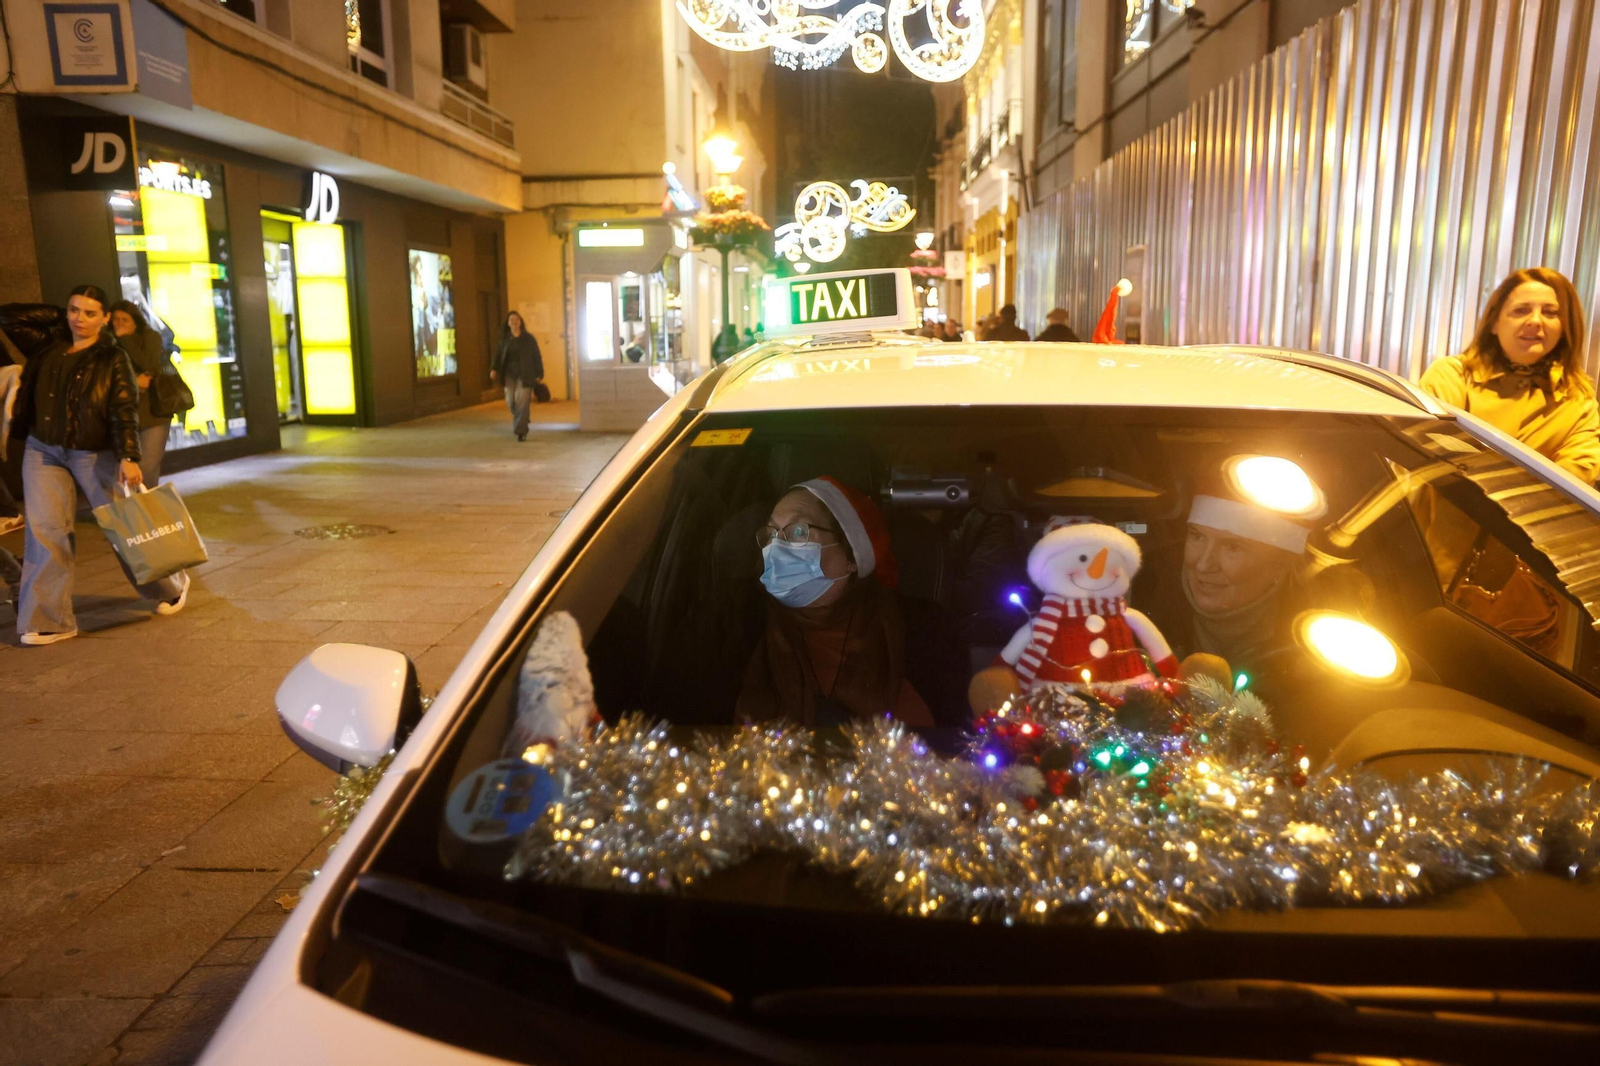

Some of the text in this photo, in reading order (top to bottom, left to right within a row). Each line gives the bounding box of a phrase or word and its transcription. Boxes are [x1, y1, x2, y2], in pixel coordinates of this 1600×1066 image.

[71, 132, 126, 174] JD
[305, 171, 341, 224] JD
[791, 278, 869, 322] TAXI
[126, 520, 185, 548] PULL&BEAR
